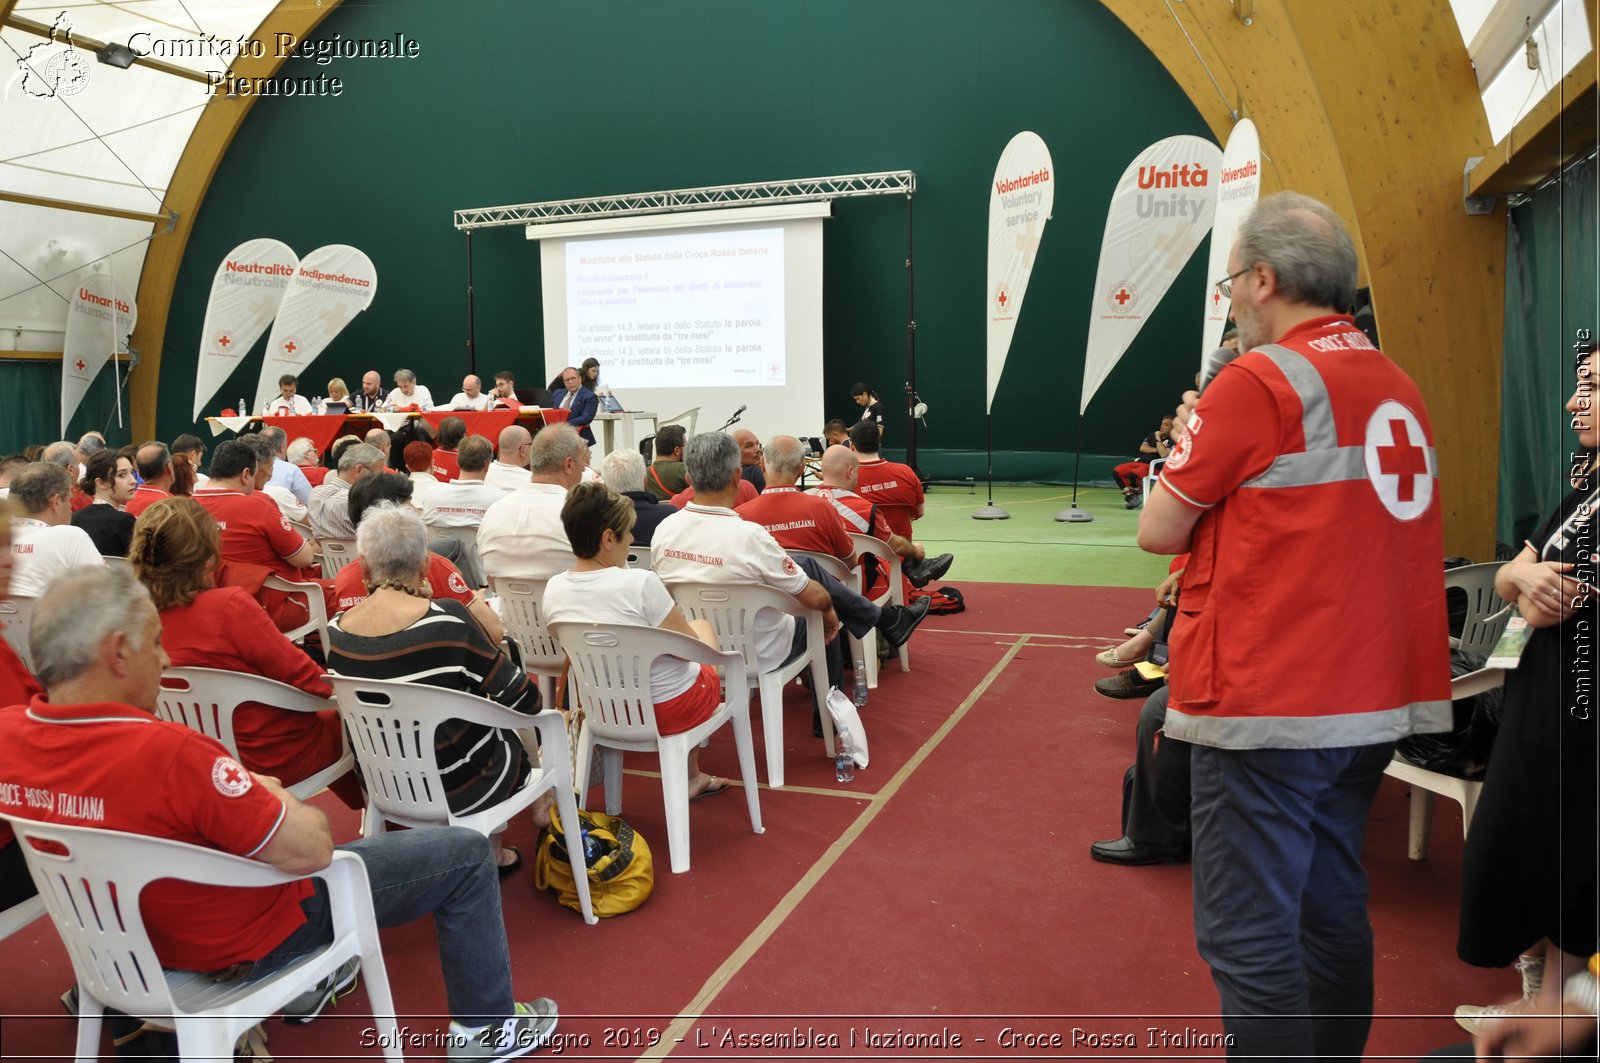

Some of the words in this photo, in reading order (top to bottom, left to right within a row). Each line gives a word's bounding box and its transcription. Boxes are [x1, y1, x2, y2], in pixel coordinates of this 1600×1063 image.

[995, 167, 1050, 195] Volontarietà
[1138, 162, 1209, 191] Unità
[1221, 160, 1257, 184] Universalità
[1001, 189, 1042, 210] Voluntary
[1136, 193, 1207, 223] Unity
[1006, 209, 1038, 228] service
[579, 255, 616, 265] Modifiche
[617, 254, 633, 263] allo
[634, 253, 663, 263] Statuto
[664, 251, 683, 261] della
[685, 250, 709, 259] Croce
[711, 248, 737, 257] Rossa
[739, 247, 768, 256] Italiana
[226, 261, 294, 276] Neutralità
[299, 267, 370, 288] Indipendenza
[80, 287, 130, 314] Umanità
[638, 321, 660, 331] lettera
[663, 321, 671, 331] a)
[674, 320, 692, 329] dello
[694, 319, 722, 329] Statuto
[725, 318, 732, 327] la
[735, 318, 761, 329] parola
[625, 332, 661, 342] sostituita
[662, 332, 673, 341] da
[1307, 334, 1350, 352] CROCE
[638, 346, 661, 355] lettera
[663, 346, 671, 356] b)
[674, 345, 692, 355] dello
[695, 344, 722, 354] Statuto
[725, 344, 732, 353] la
[735, 343, 761, 355] parola
[627, 356, 663, 366] sostituita
[664, 356, 675, 365] da
[789, 519, 816, 530] ITALIANA
[664, 549, 681, 559] CROCE
[696, 554, 723, 566] ITALIANA
[58, 792, 104, 821] ITALIANA
